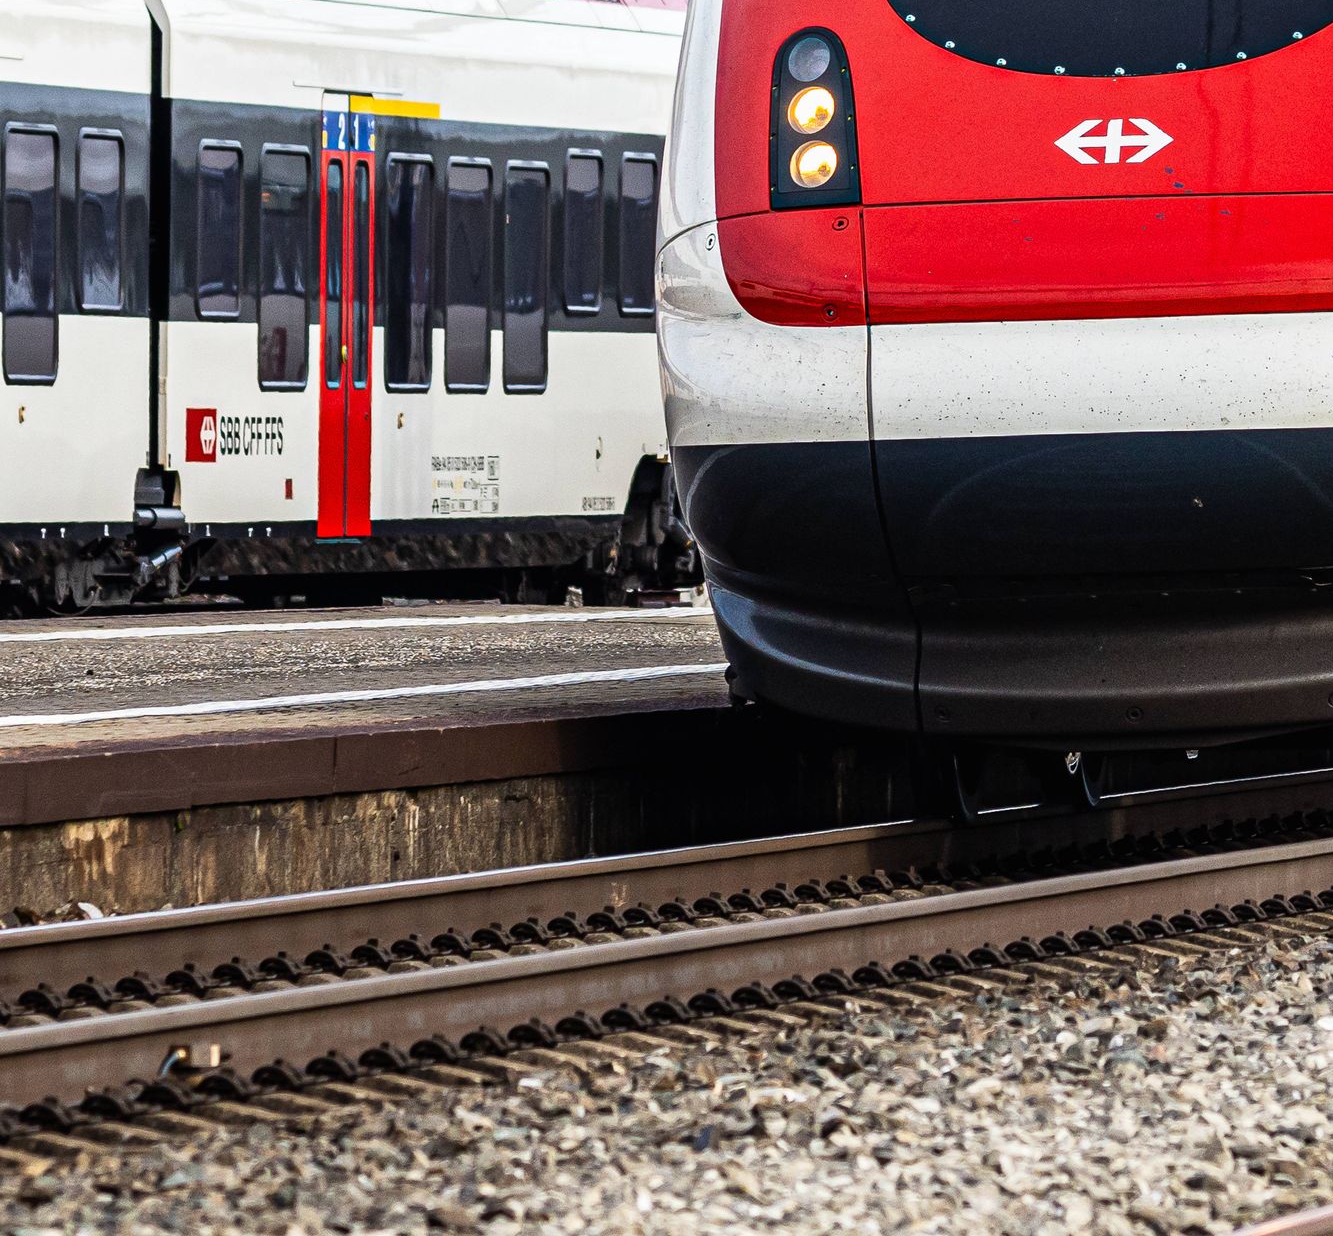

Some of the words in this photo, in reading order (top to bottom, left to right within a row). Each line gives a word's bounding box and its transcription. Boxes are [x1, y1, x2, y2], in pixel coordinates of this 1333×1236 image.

[338, 112, 346, 150] 2
[353, 114, 359, 150] 1
[220, 416, 241, 455] SBB
[243, 416, 262, 455] CFF
[264, 416, 284, 455] FFS
